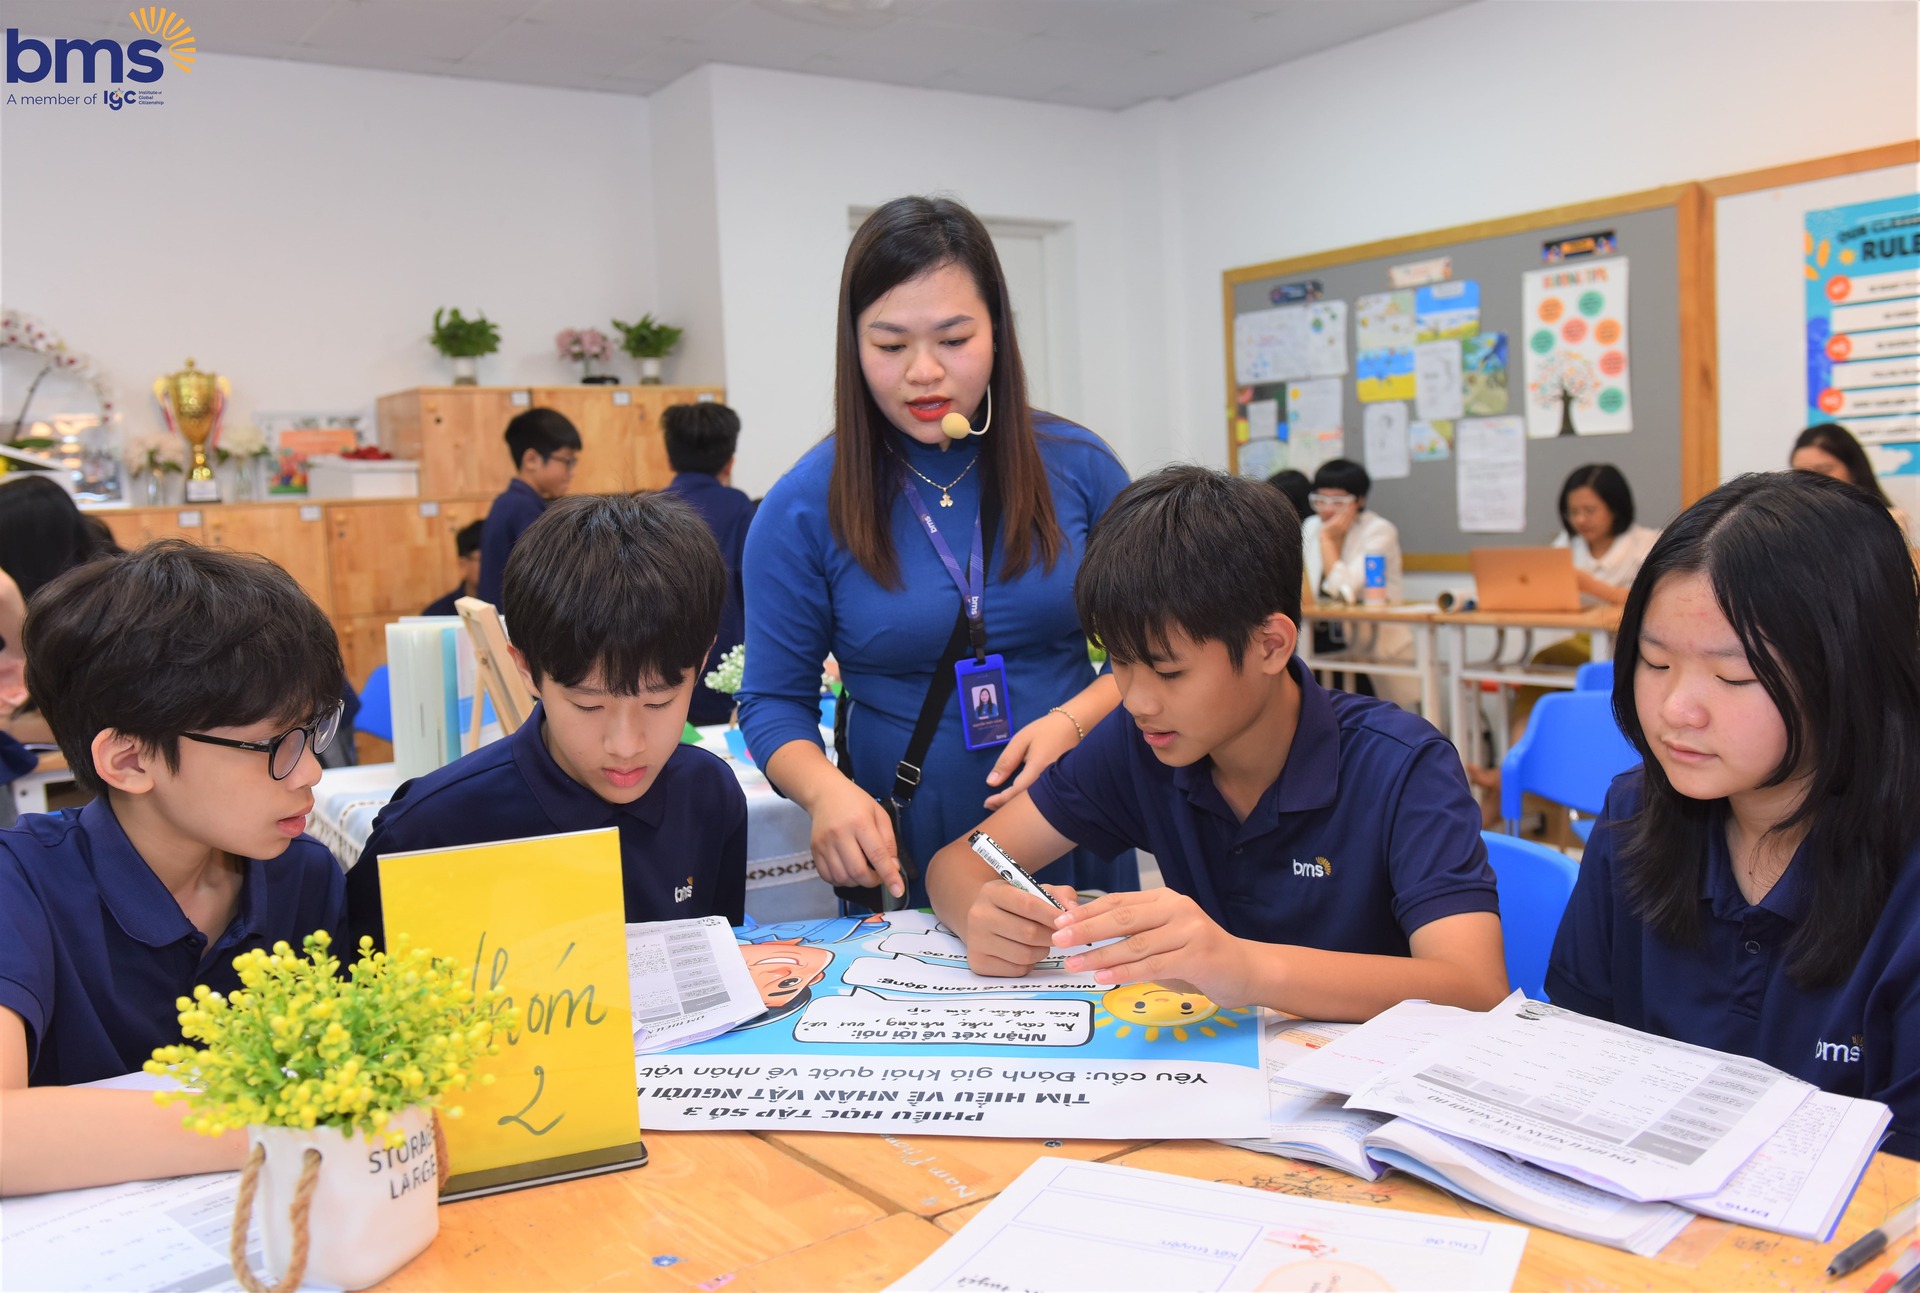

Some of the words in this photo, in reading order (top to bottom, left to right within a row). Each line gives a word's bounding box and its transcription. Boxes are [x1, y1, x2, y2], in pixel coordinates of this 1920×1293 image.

[1862, 231, 1920, 262] RULE
[925, 515, 938, 534] bms
[971, 596, 980, 616] bms
[1293, 858, 1324, 878] bms
[851, 1030, 888, 1039] nói:
[892, 1031, 918, 1040] lời
[922, 1031, 946, 1041] về
[952, 1031, 988, 1040] xét
[993, 1031, 1046, 1042] Nhận
[639, 1064, 684, 1079] vật
[693, 1067, 760, 1079] nhân
[765, 1067, 798, 1081] về
[808, 1066, 874, 1081] quát
[881, 1070, 941, 1081] khái
[951, 1067, 993, 1082] giá
[1002, 1071, 1076, 1083] Đánh
[1086, 1072, 1147, 1086] cầu:
[1156, 1073, 1208, 1085] Yêu
[497, 1065, 567, 1136] 2
[651, 1088, 743, 1101] NGƯỜI
[747, 1087, 804, 1103] VẬT
[813, 1090, 899, 1104] NHÂN
[907, 1092, 944, 1107] VỀ
[1035, 1093, 1090, 1107] TÌM
[682, 1107, 703, 1116] 3
[709, 1108, 750, 1120] SỐ
[755, 1106, 812, 1120] TẬP
[821, 1108, 884, 1120] HỌC
[891, 1111, 985, 1124] PHIẾU
[390, 1153, 437, 1200] LARGE
[928, 1167, 977, 1199] Nam
